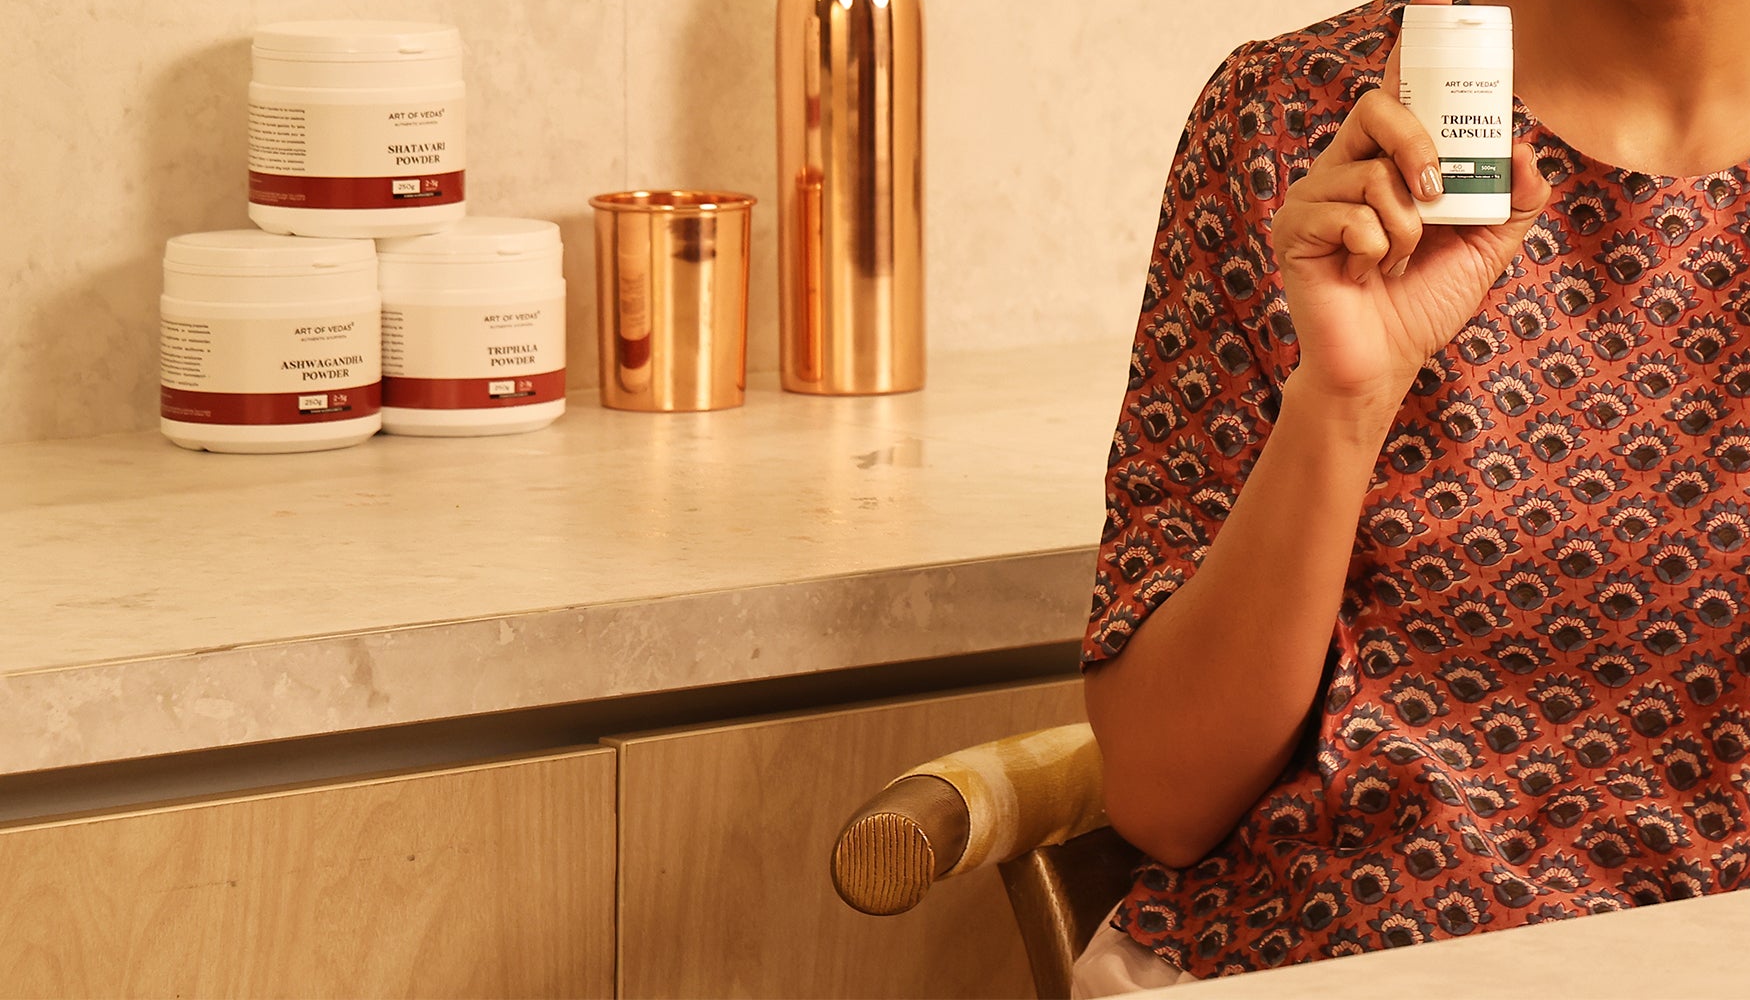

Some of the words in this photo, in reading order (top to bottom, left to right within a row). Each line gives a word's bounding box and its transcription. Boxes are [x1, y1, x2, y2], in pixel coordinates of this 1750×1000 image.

[388, 112, 405, 120] ART
[1440, 114, 1502, 125] TRIPHALA
[1440, 128, 1502, 139] CAPSULES
[387, 141, 446, 154] SHATAVARI
[395, 154, 441, 166] POWDER
[502, 314, 513, 322] OF
[294, 327, 312, 335] ART
[314, 326, 326, 334] OF
[487, 344, 538, 355] TRIPHALA
[280, 355, 364, 370] ASHWAGANDHA
[491, 355, 536, 367] POWDER
[302, 368, 350, 381] POWDER
